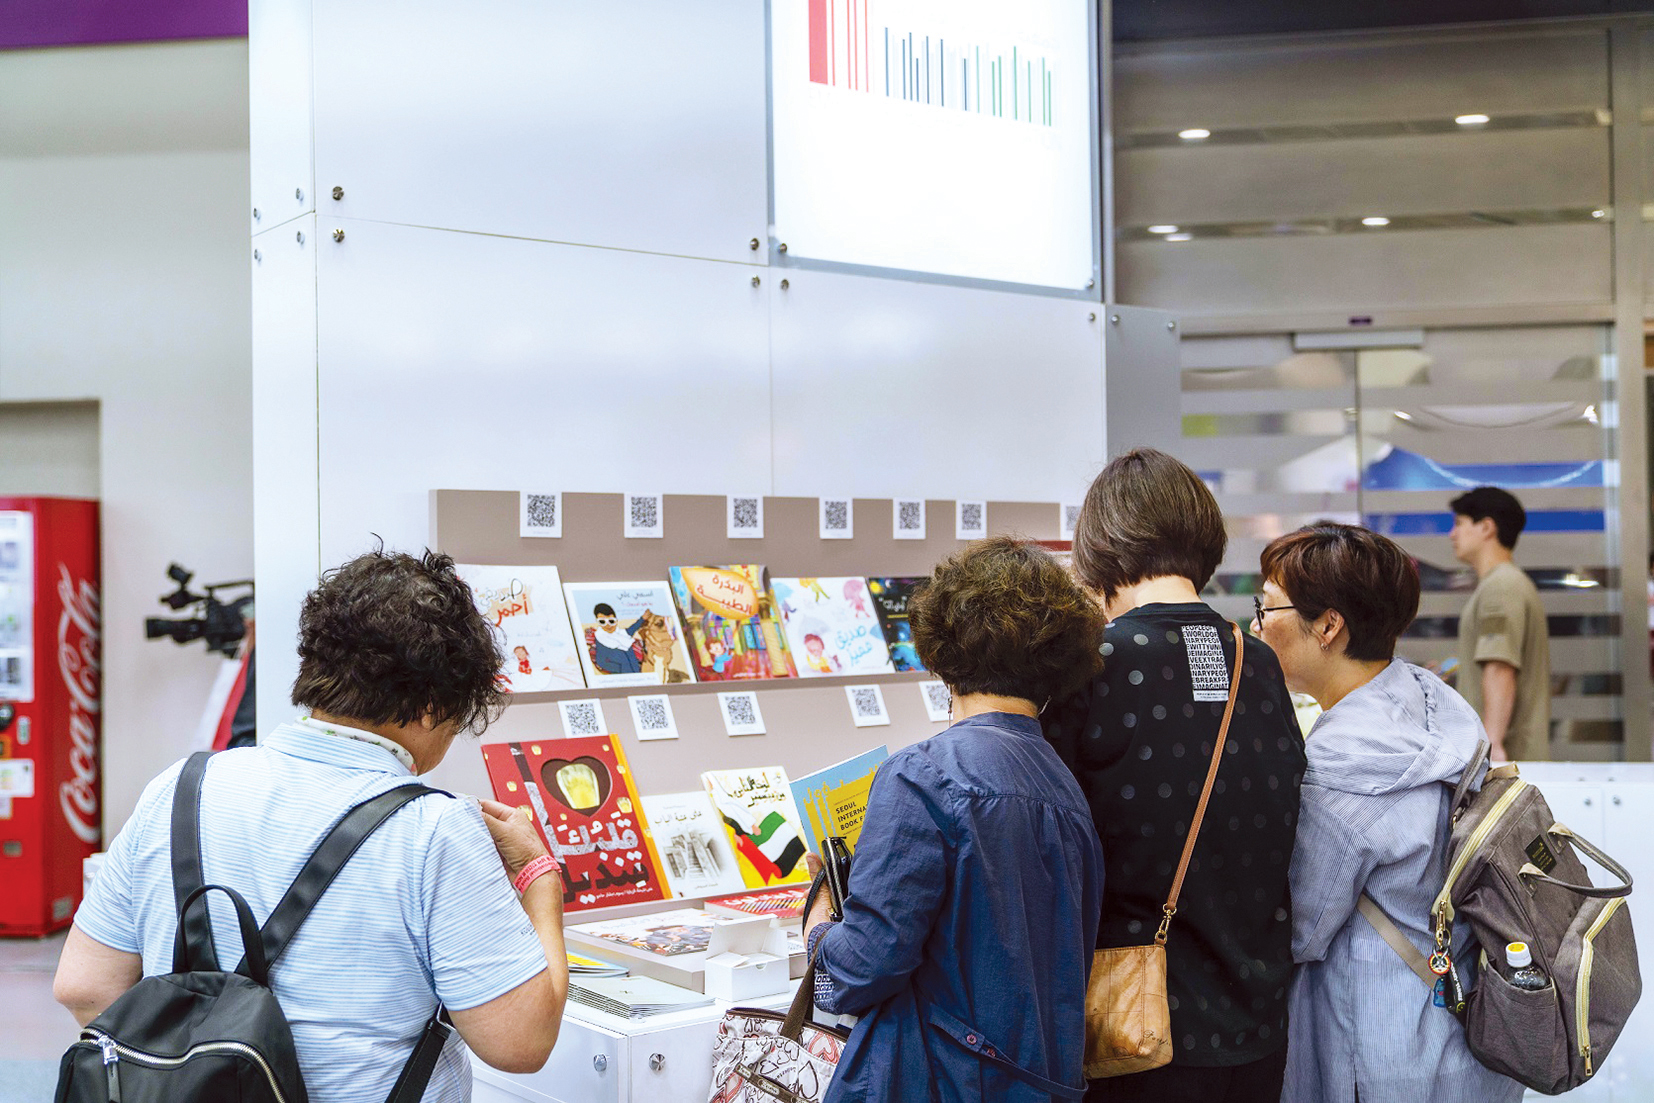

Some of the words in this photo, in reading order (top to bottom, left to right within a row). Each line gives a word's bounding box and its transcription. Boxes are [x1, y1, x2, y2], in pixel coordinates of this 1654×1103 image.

[835, 801, 857, 815] SEOUL
[837, 805, 867, 823] INTERNA
[840, 818, 859, 831] BOOK
